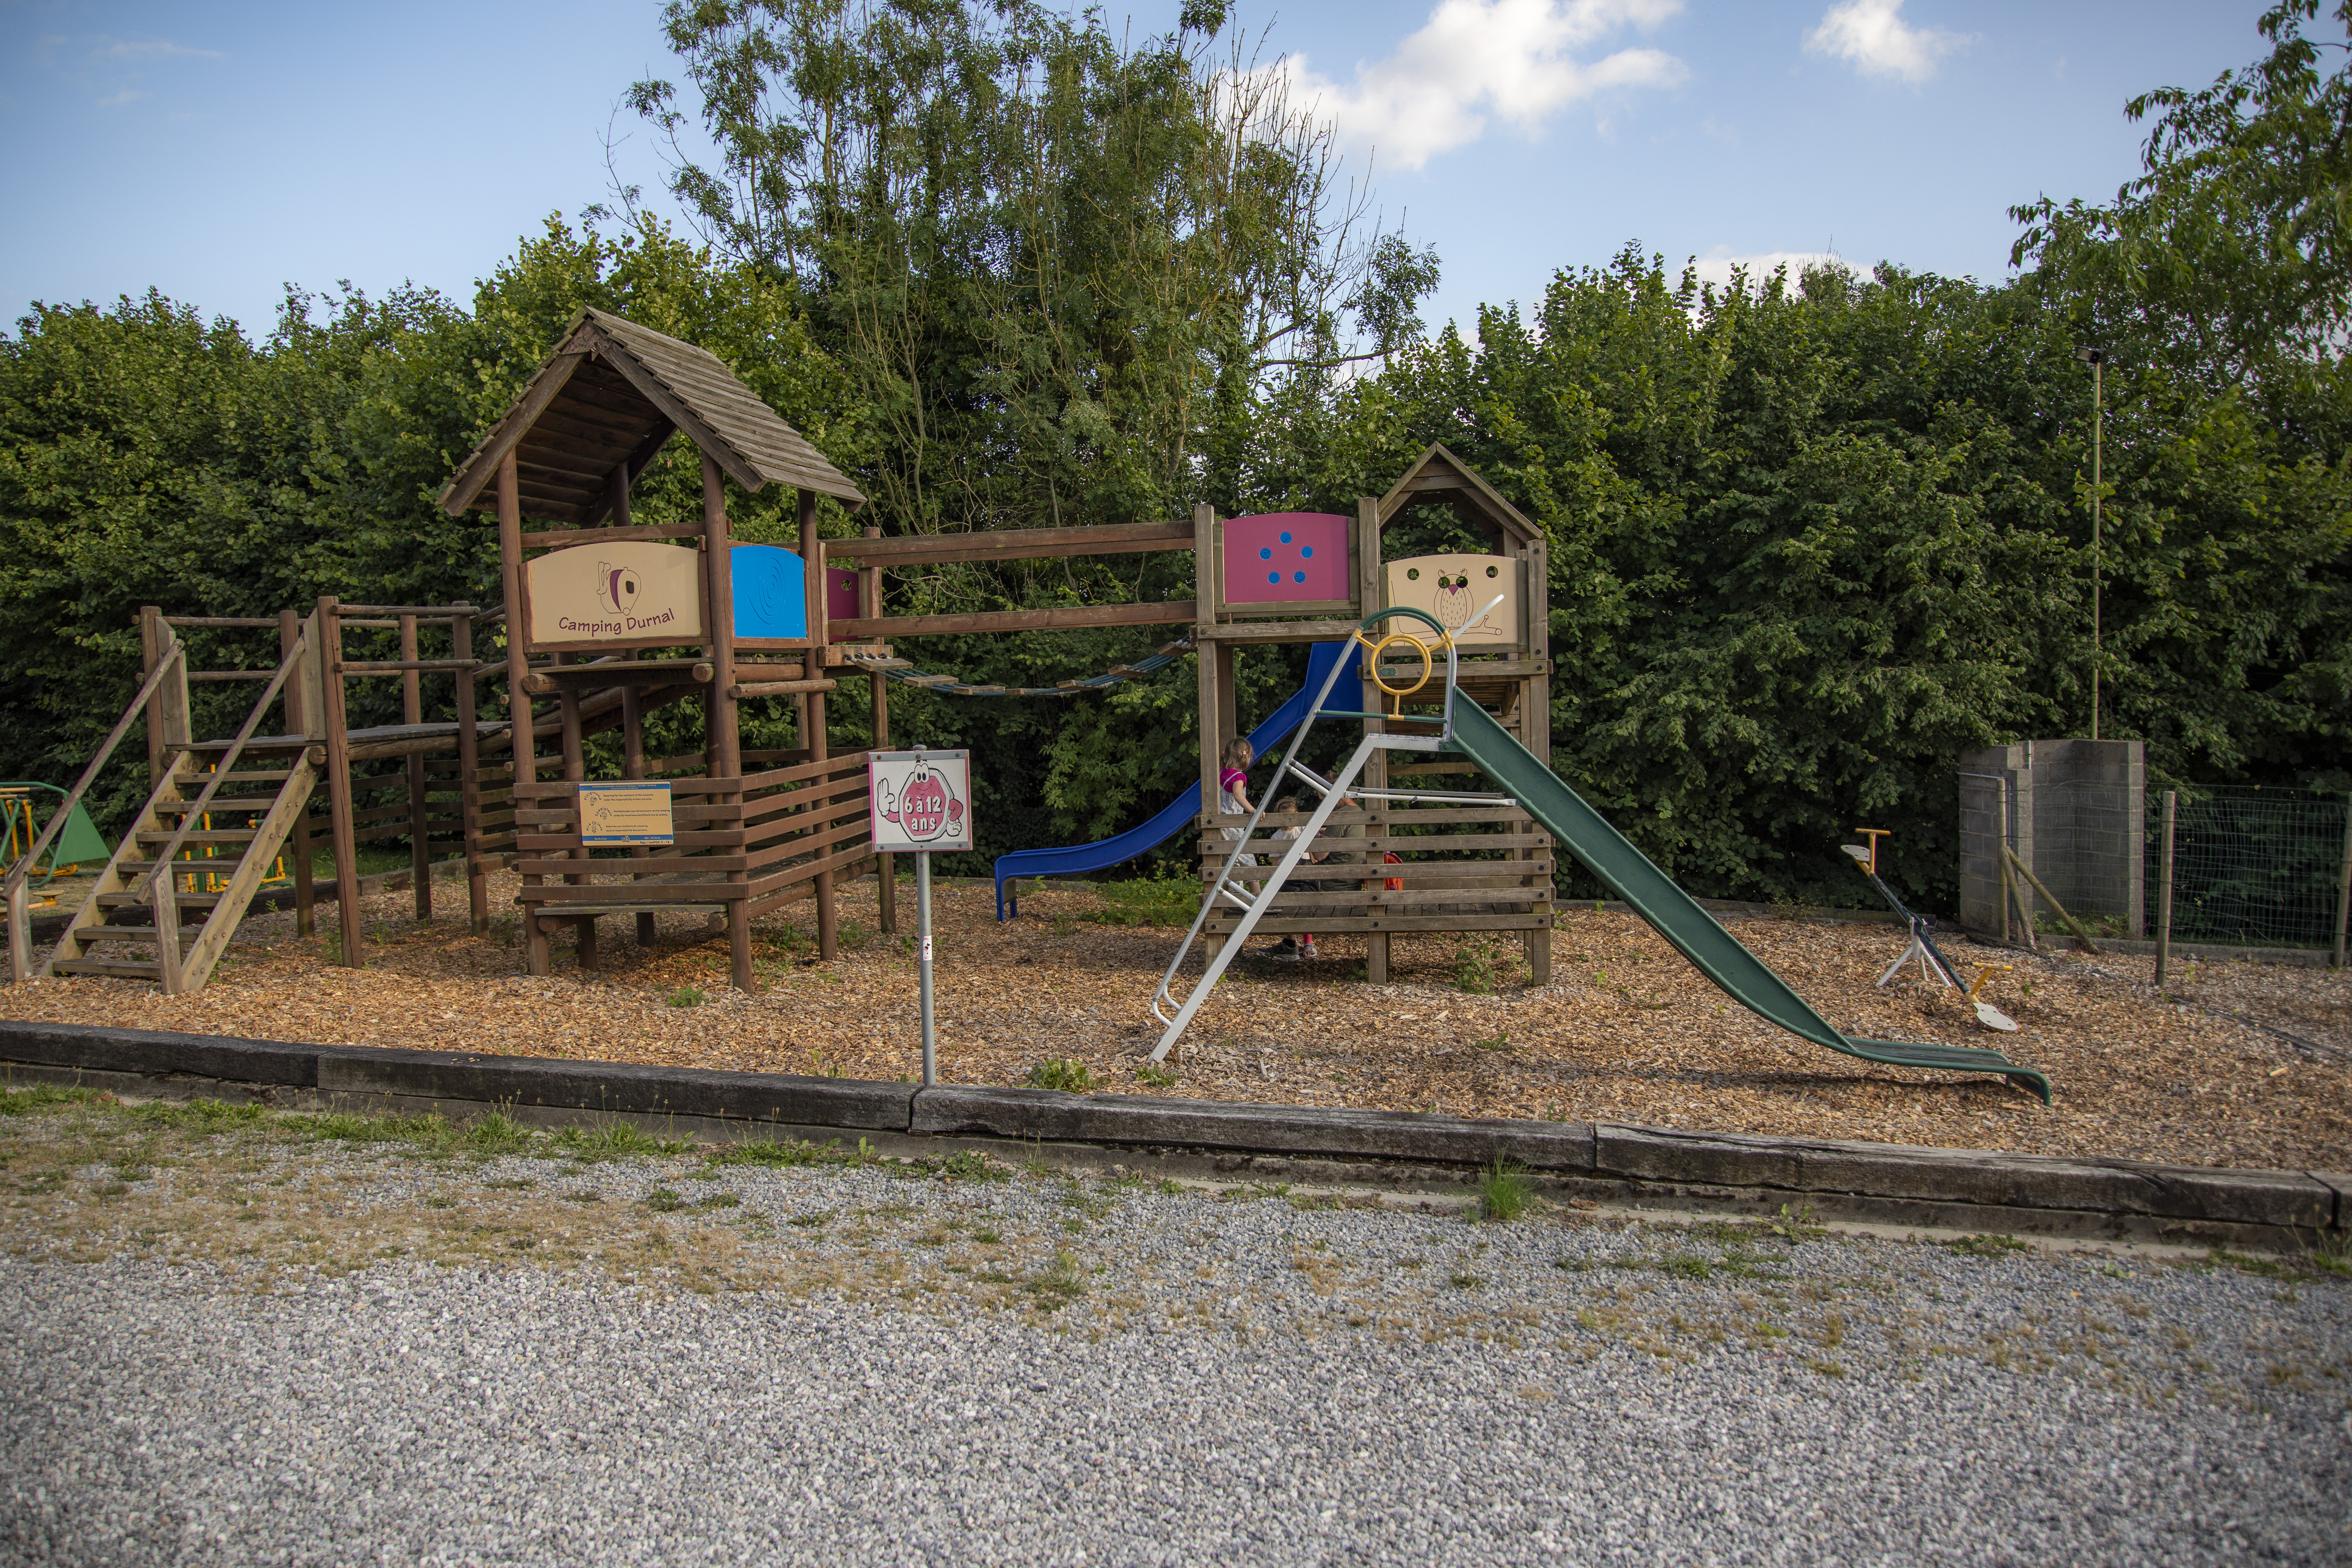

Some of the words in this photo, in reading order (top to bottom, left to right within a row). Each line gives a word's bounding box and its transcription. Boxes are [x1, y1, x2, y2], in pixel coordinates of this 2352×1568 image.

[559, 617, 622, 637] Camping
[626, 608, 675, 630] Durnal
[584, 791, 602, 800] Playground
[595, 806, 612, 816] Speelplein
[905, 796, 914, 814] 6
[916, 796, 923, 814] à
[926, 795, 942, 814] 12
[911, 817, 936, 831] ans
